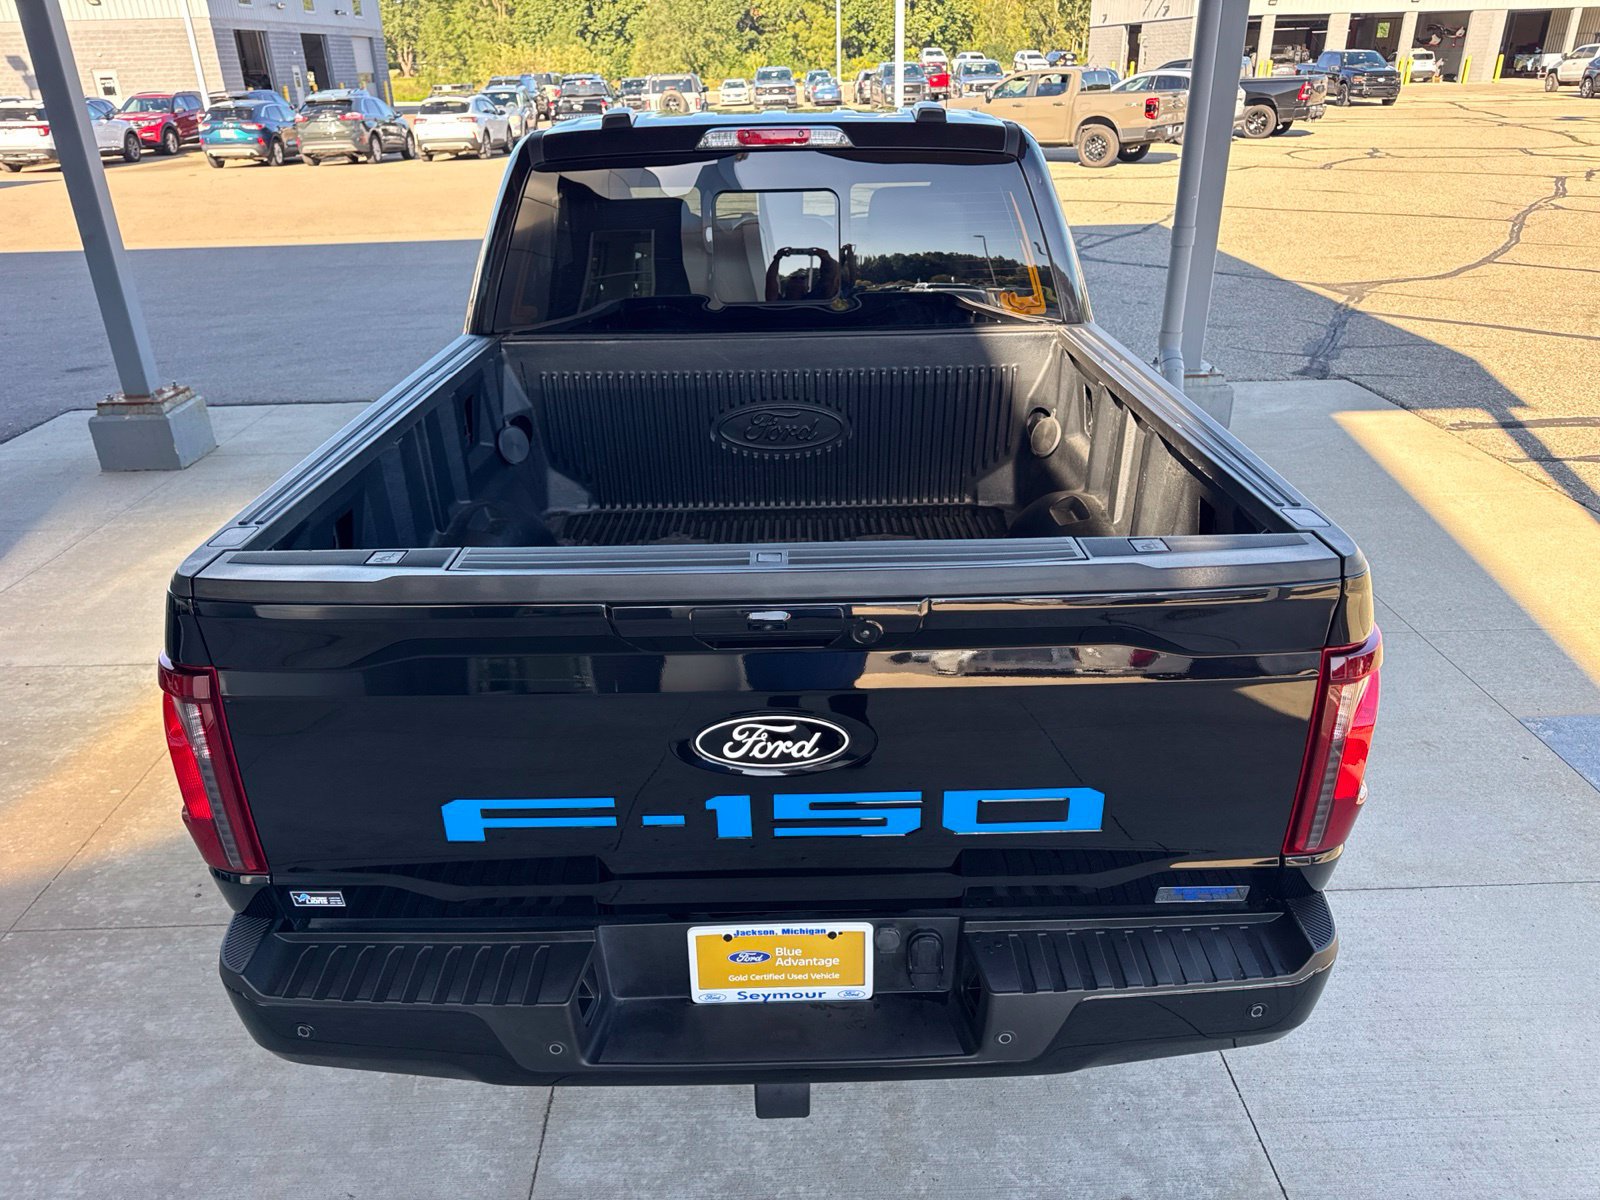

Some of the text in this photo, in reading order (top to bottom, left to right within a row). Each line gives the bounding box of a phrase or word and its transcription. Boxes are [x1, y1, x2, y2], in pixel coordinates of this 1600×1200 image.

[744, 409, 819, 441] Ford
[722, 723, 820, 761] Ford
[441, 787, 1106, 842] F-150
[733, 928, 827, 938] Jackson, Michigan
[775, 947, 802, 956] Blue
[735, 952, 764, 963] Ford
[775, 957, 840, 967] Advantage
[728, 972, 840, 982] Gold Certified Used Vehicle
[737, 991, 826, 1003] Seymour
